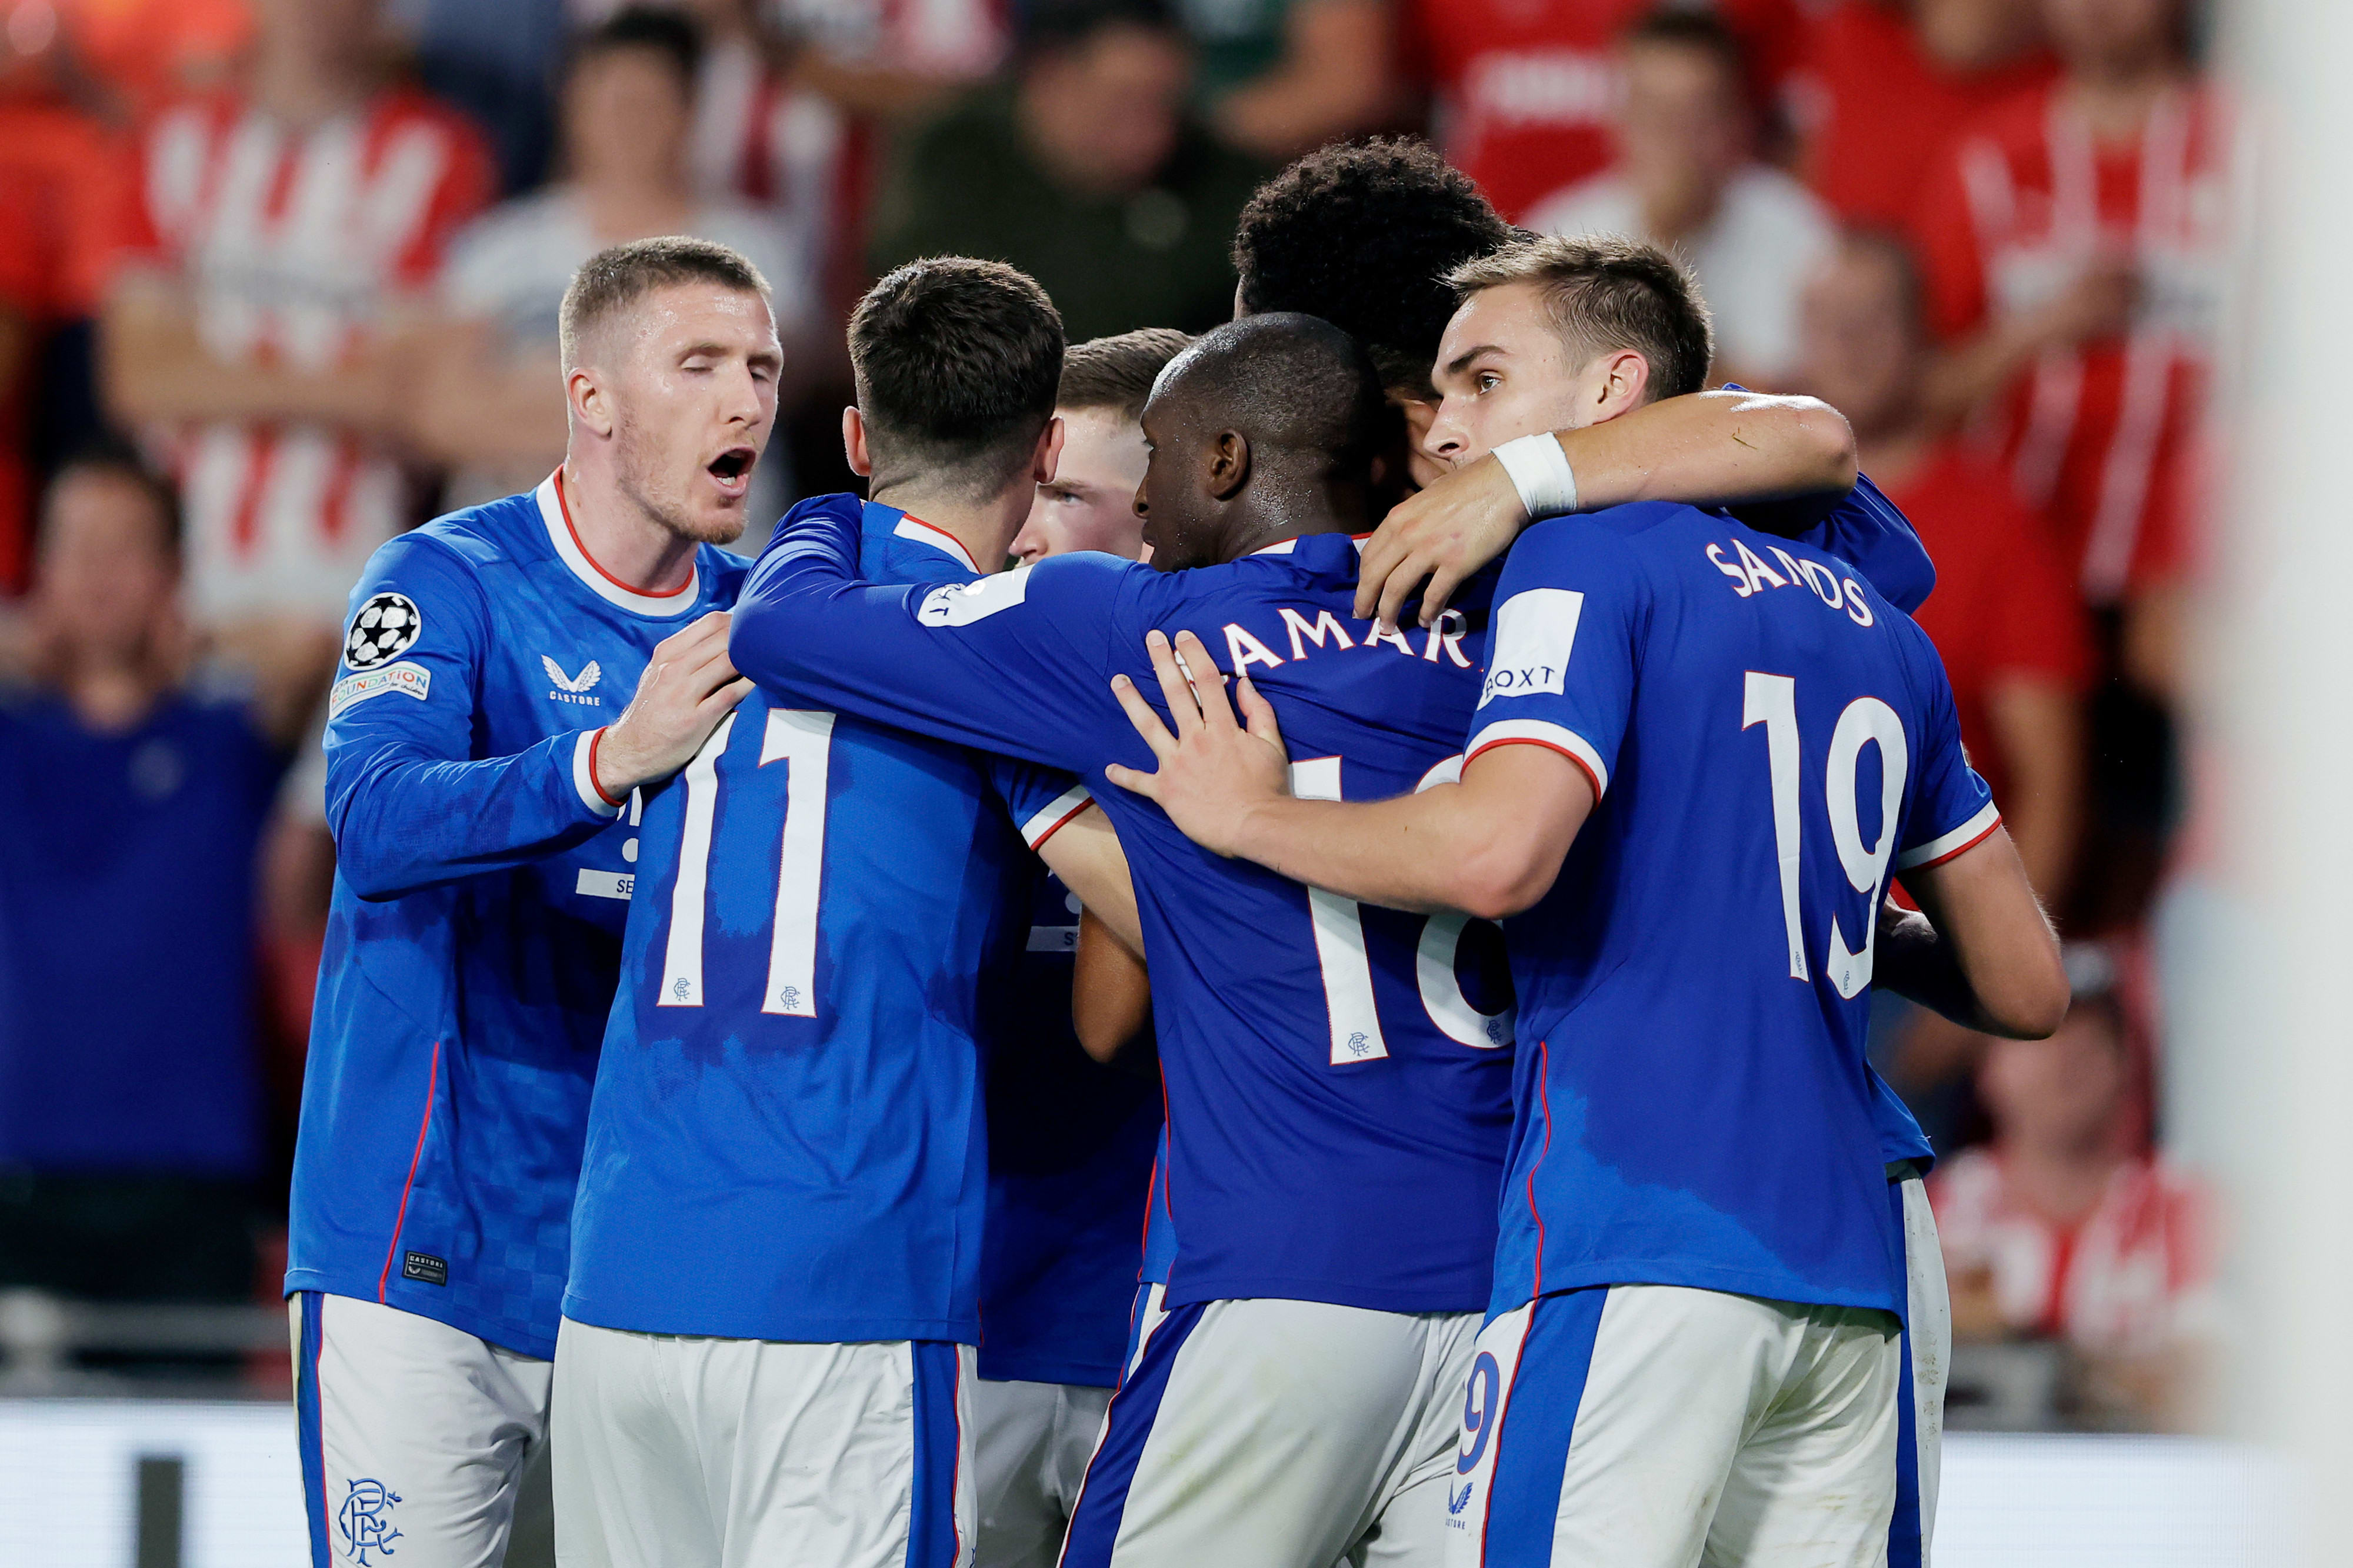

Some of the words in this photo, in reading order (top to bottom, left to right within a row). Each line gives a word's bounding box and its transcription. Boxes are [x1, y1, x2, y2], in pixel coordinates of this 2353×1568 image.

[1705, 538, 1874, 628] SANDS
[549, 690, 600, 706] CASTORE
[1175, 608, 1484, 706] AMAR
[656, 708, 837, 1018] 11
[1742, 669, 1908, 1000] 19
[409, 1255, 443, 1268] CASTORE
